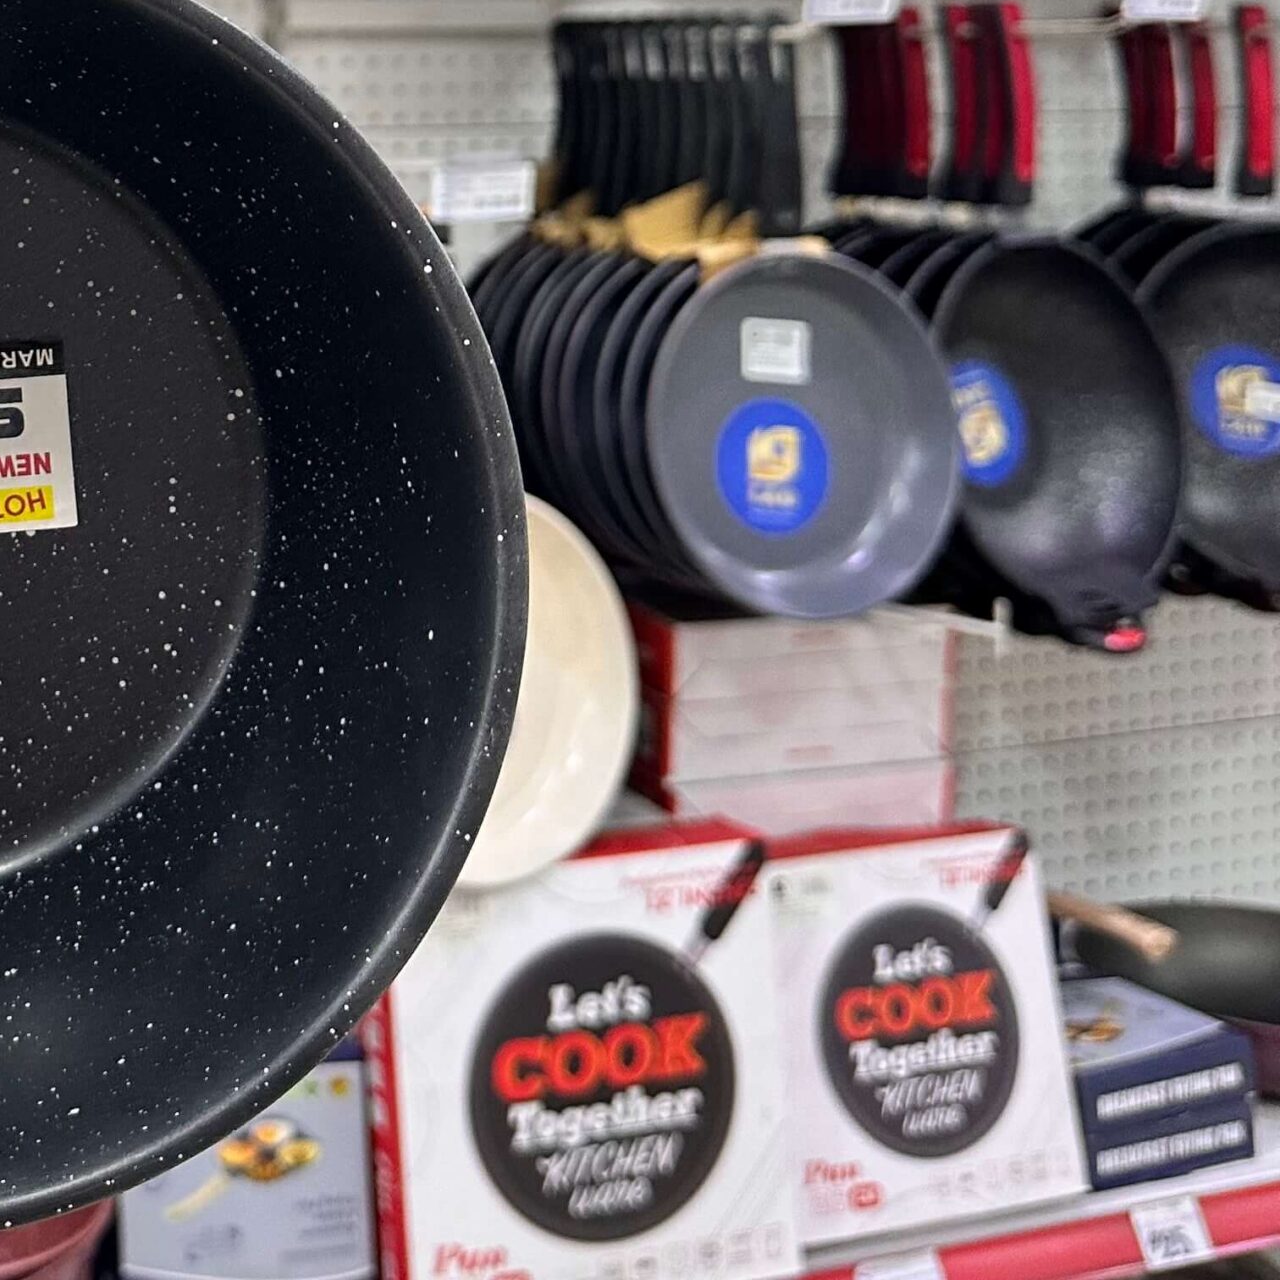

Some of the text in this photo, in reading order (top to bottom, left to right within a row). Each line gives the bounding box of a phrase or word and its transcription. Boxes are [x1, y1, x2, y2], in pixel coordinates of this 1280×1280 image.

[872, 936, 954, 983] Let's
[547, 974, 651, 1031] Let's
[834, 969, 997, 1042] COOK
[491, 1013, 710, 1101] COOK
[849, 1028, 999, 1085] Together
[507, 1084, 704, 1151] Together
[875, 1070, 988, 1120] KITCHEN
[536, 1131, 684, 1198] KITCHEN
